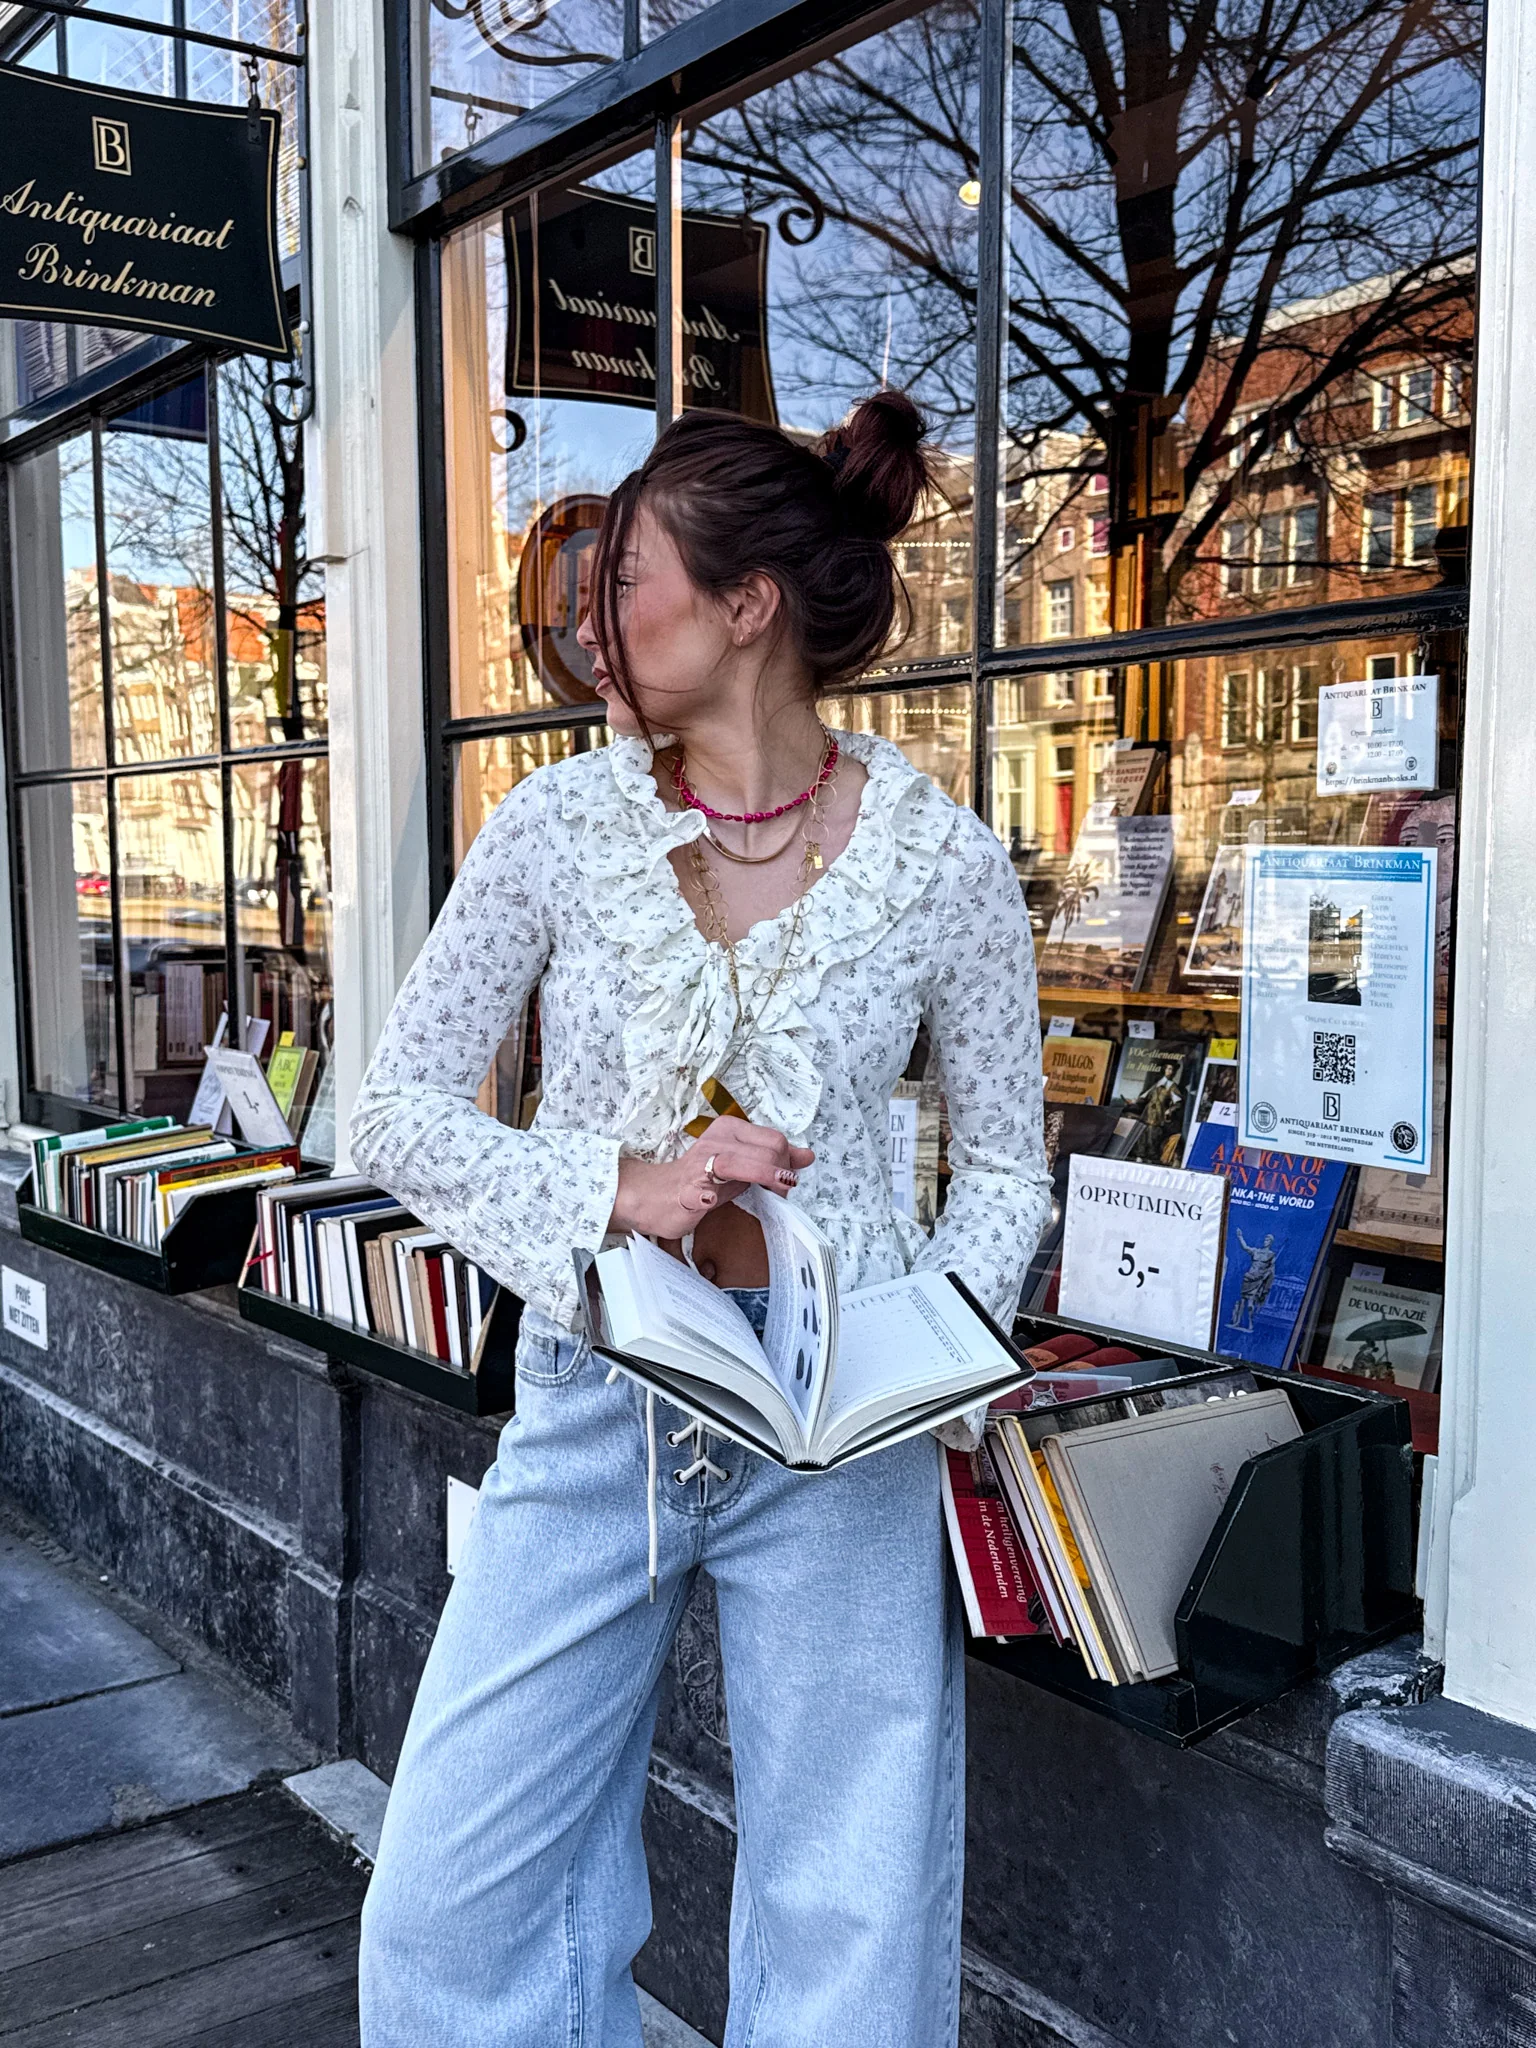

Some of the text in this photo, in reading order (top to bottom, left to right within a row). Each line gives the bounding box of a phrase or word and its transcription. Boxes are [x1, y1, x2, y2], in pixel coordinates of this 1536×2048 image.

[98, 123, 126, 168] B
[0, 180, 235, 250] Antiquariaat
[18, 242, 217, 308] Brinkman
[1372, 701, 1381, 718] B
[1325, 773, 1418, 787] https://brinkmanbooks.nl
[1354, 855, 1421, 871] BRINKMAN
[1052, 1052, 1095, 1071] FIDALGOS
[1326, 1095, 1338, 1118] B
[1280, 1117, 1339, 1132] ANTIQUARIAAT
[1340, 1126, 1384, 1139] BRINKMAN
[1305, 1140, 1355, 1153] THE NETHERLANDS
[1341, 1137, 1374, 1147] AMSTERDAM
[1211, 1143, 1327, 1177] A RIGN OF
[1254, 1170, 1320, 1198] KINGS
[1079, 1184, 1203, 1221] OPRUIMING
[1278, 1195, 1315, 1210] WORLD
[1117, 1240, 1160, 1288] 5,-
[1347, 1297, 1362, 1310] DE
[1388, 1306, 1401, 1318] IN
[978, 1500, 989, 1511] in
[996, 1500, 1006, 1513] en
[981, 1513, 993, 1528] de
[984, 1529, 1009, 1598] Nederlanden
